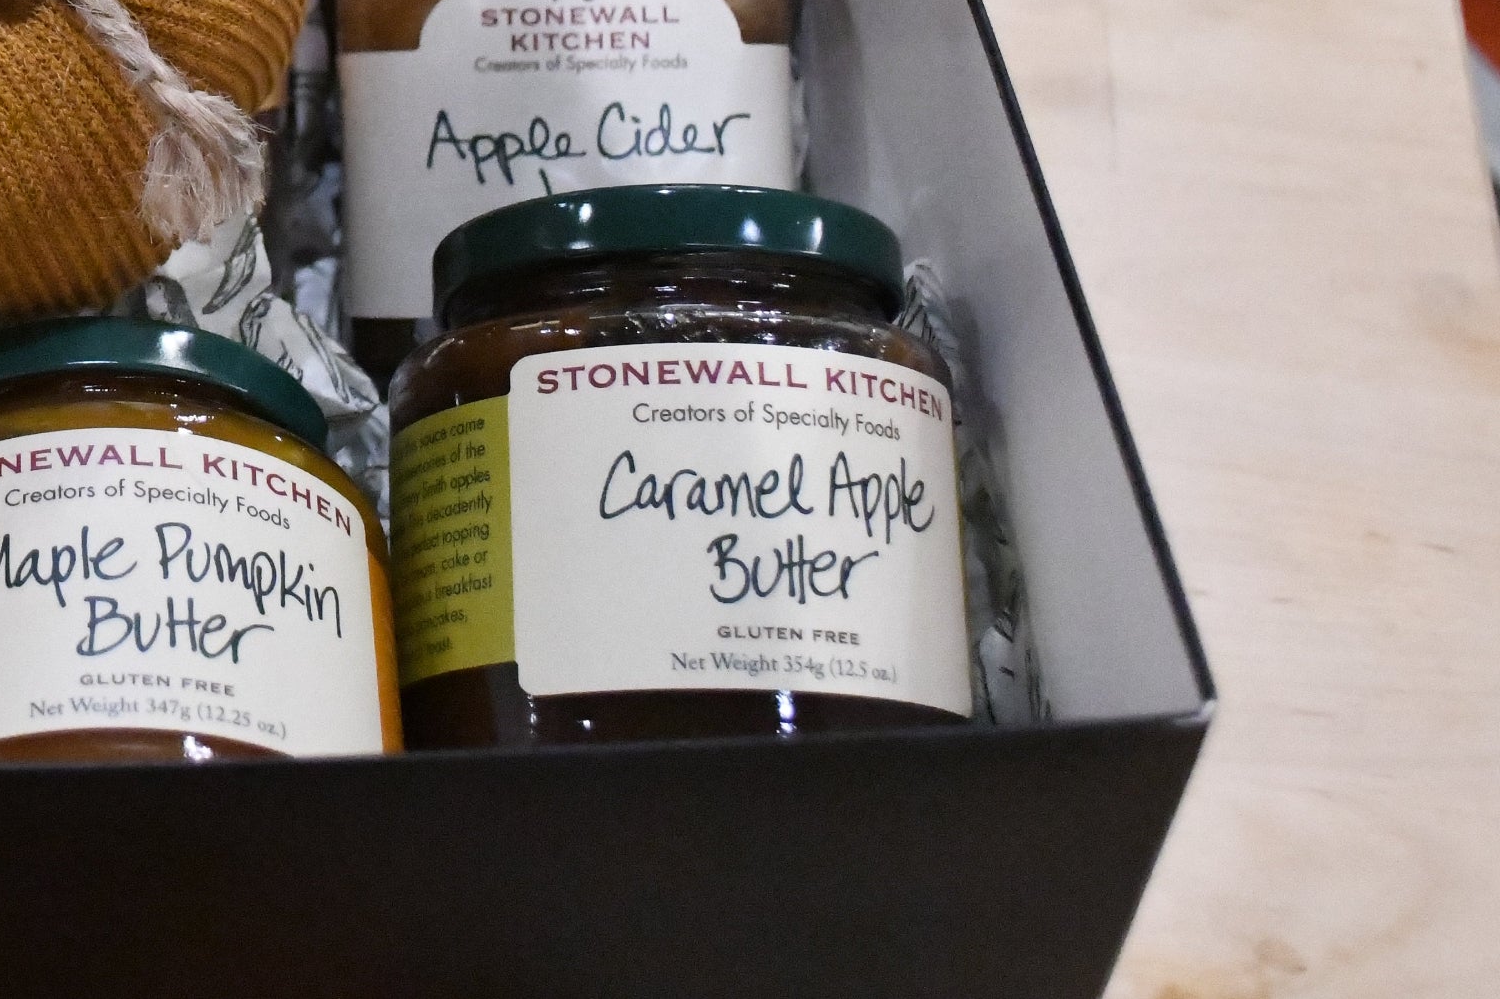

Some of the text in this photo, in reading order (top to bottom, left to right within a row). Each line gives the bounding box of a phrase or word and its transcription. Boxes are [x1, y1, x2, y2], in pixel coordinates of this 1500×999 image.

[479, 5, 681, 29] STONEWALL
[509, 31, 652, 53] KITCHEN
[473, 54, 689, 74] Creators of Specialty Foods
[426, 109, 587, 186] Apple
[598, 101, 751, 162] Cider
[536, 359, 943, 422] STONEWALL KITCHEN
[632, 400, 900, 441] Creators of Specialty Foods
[466, 442, 485, 460] the
[202, 452, 353, 538] KITCHEN
[450, 466, 491, 493] apples
[599, 449, 935, 544] Caramel Apple
[3, 479, 292, 532] Creators of Specialty Foods
[155, 522, 344, 639] Pumpkin
[707, 533, 880, 605] Butter
[75, 595, 275, 665] Butter
[717, 625, 862, 647] GLUTEN FREE
[79, 672, 236, 697] GLUTEN FREE
[670, 651, 899, 684] Net Weight 354g (12.5 oz.)
[28, 696, 288, 742] Net Weight 347g (12.25 oz.)
